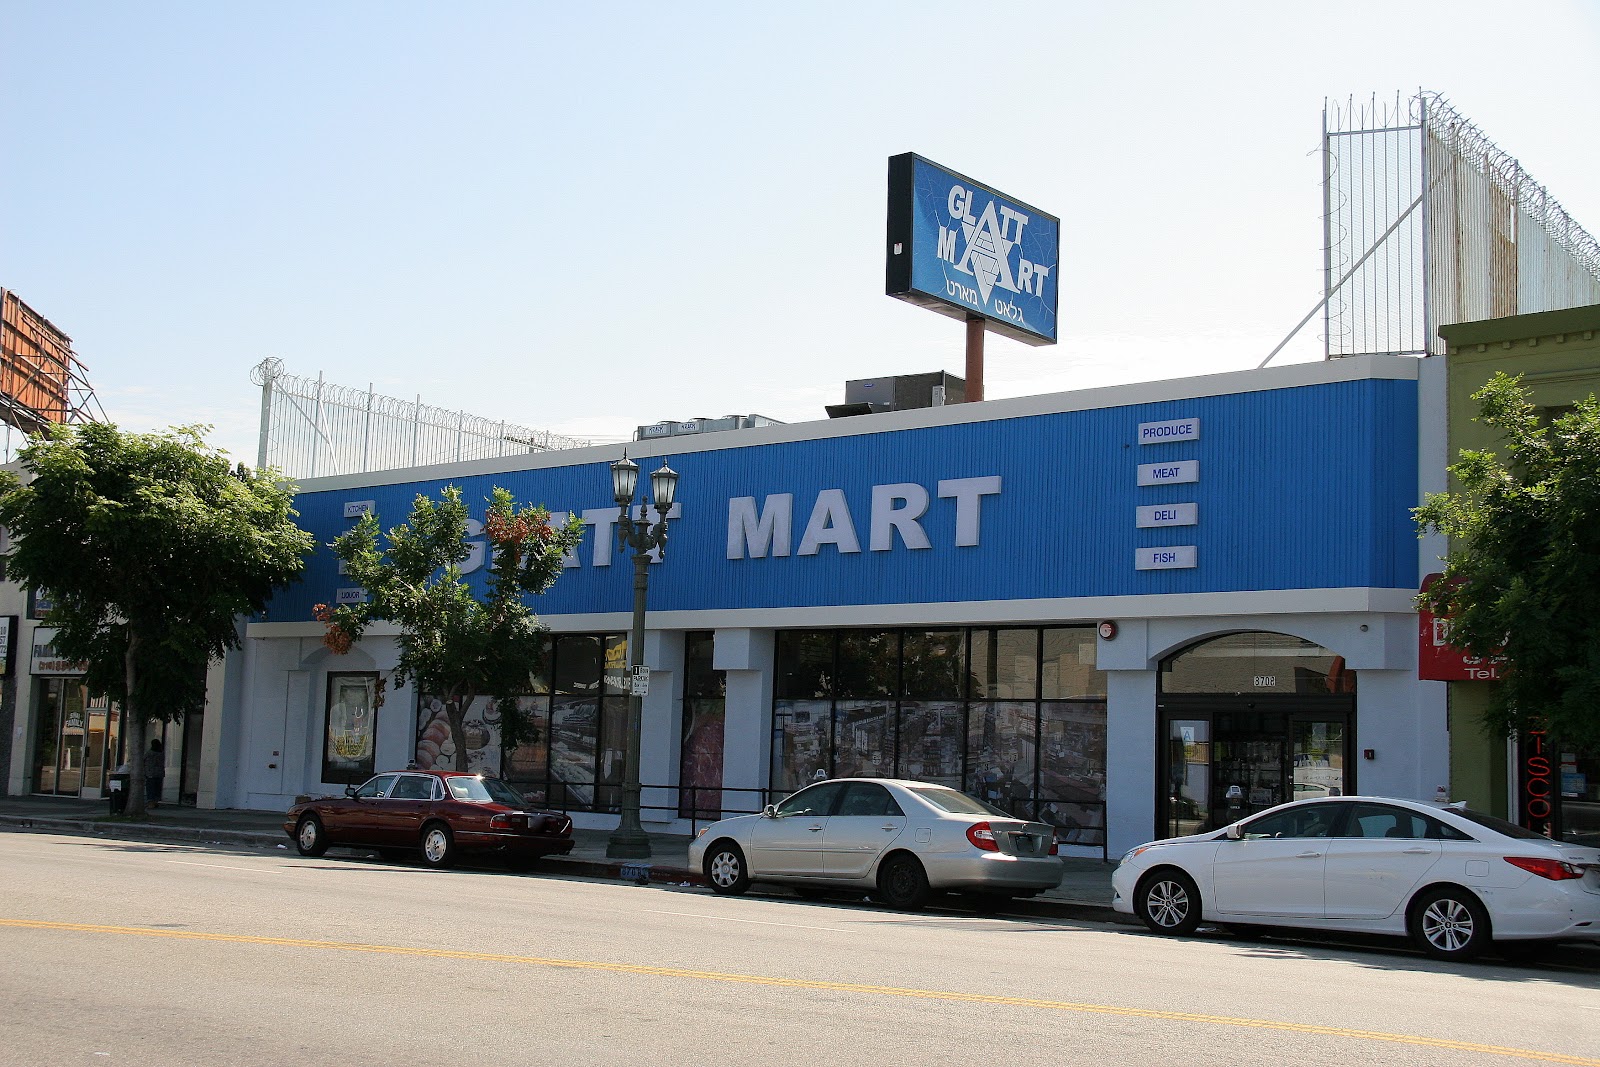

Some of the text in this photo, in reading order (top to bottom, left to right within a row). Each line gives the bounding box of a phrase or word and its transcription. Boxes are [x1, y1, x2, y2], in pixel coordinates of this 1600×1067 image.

[948, 185, 1029, 250] GLATT
[937, 210, 1049, 297] MART
[946, 279, 1024, 323] גלאט מארט
[1143, 424, 1192, 439] PRODUCE
[1152, 467, 1180, 479] MEAT
[1154, 509, 1177, 521] DELI
[448, 475, 1003, 575] GTT MART
[1153, 552, 1176, 564] FISH
[1463, 667, 1500, 680] Tel.
